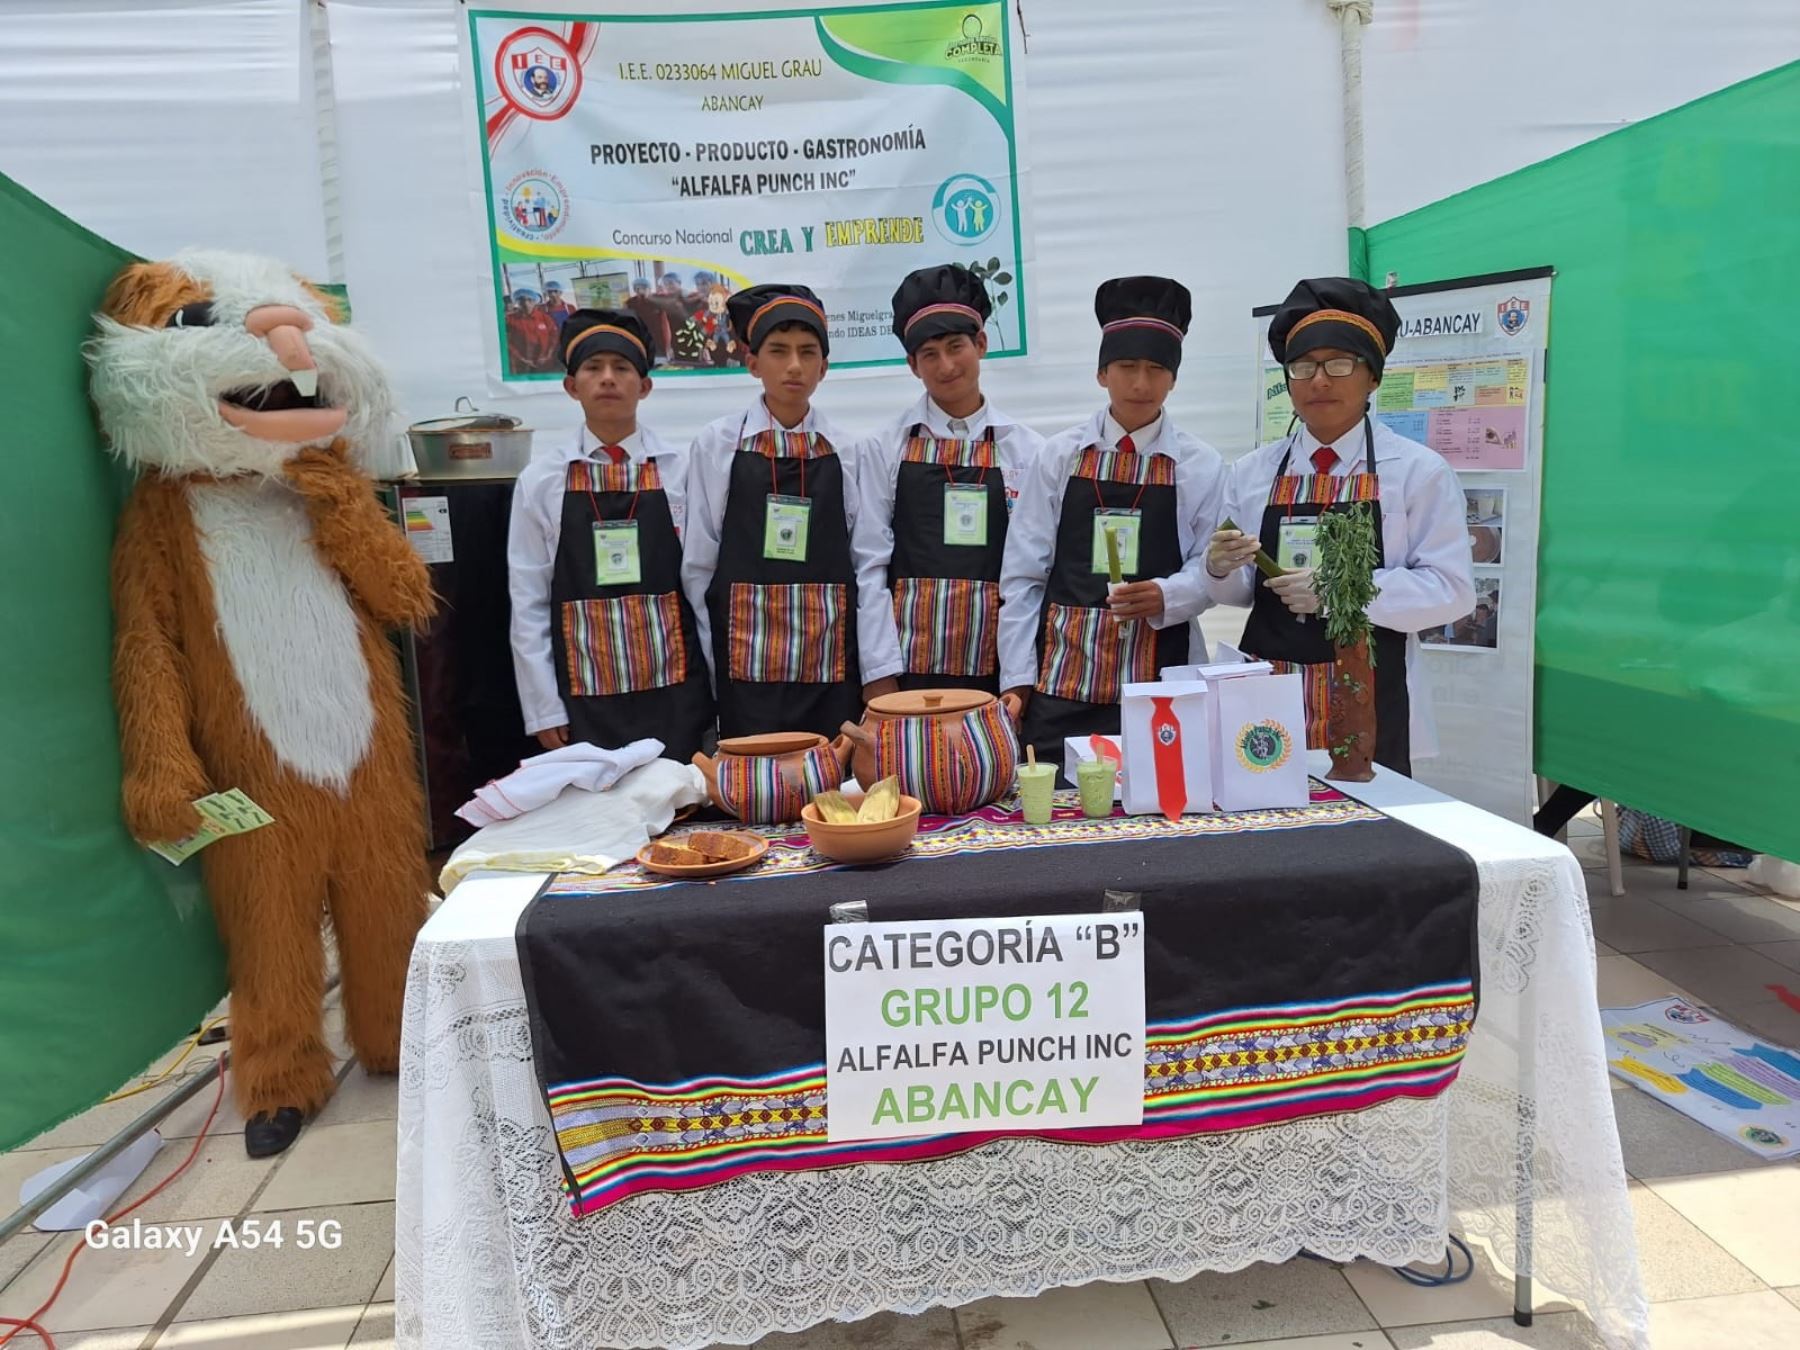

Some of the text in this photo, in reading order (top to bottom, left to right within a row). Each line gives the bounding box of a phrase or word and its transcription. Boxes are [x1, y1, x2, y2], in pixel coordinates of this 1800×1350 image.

[619, 58, 822, 80] I.E.E. 0233064 MIGUEL GRAU
[945, 42, 1002, 60] COMPLETA
[701, 95, 763, 112] ABANCAY
[591, 123, 926, 164] PROYECTO PRODUCTO GASTRONOMÍA
[756, 172, 815, 194] PUNCH
[612, 217, 924, 256] Concurso Nacional CREA Y EMPRENDE
[828, 327, 845, 338] ndo
[848, 326, 877, 338] IDEAS
[829, 920, 1138, 973] CATEGORÍA “B”
[881, 981, 1089, 1027] GRUPO 12
[837, 1033, 1132, 1072] ALFALFA PUNCH INC
[872, 1077, 1099, 1125] ABANCAY
